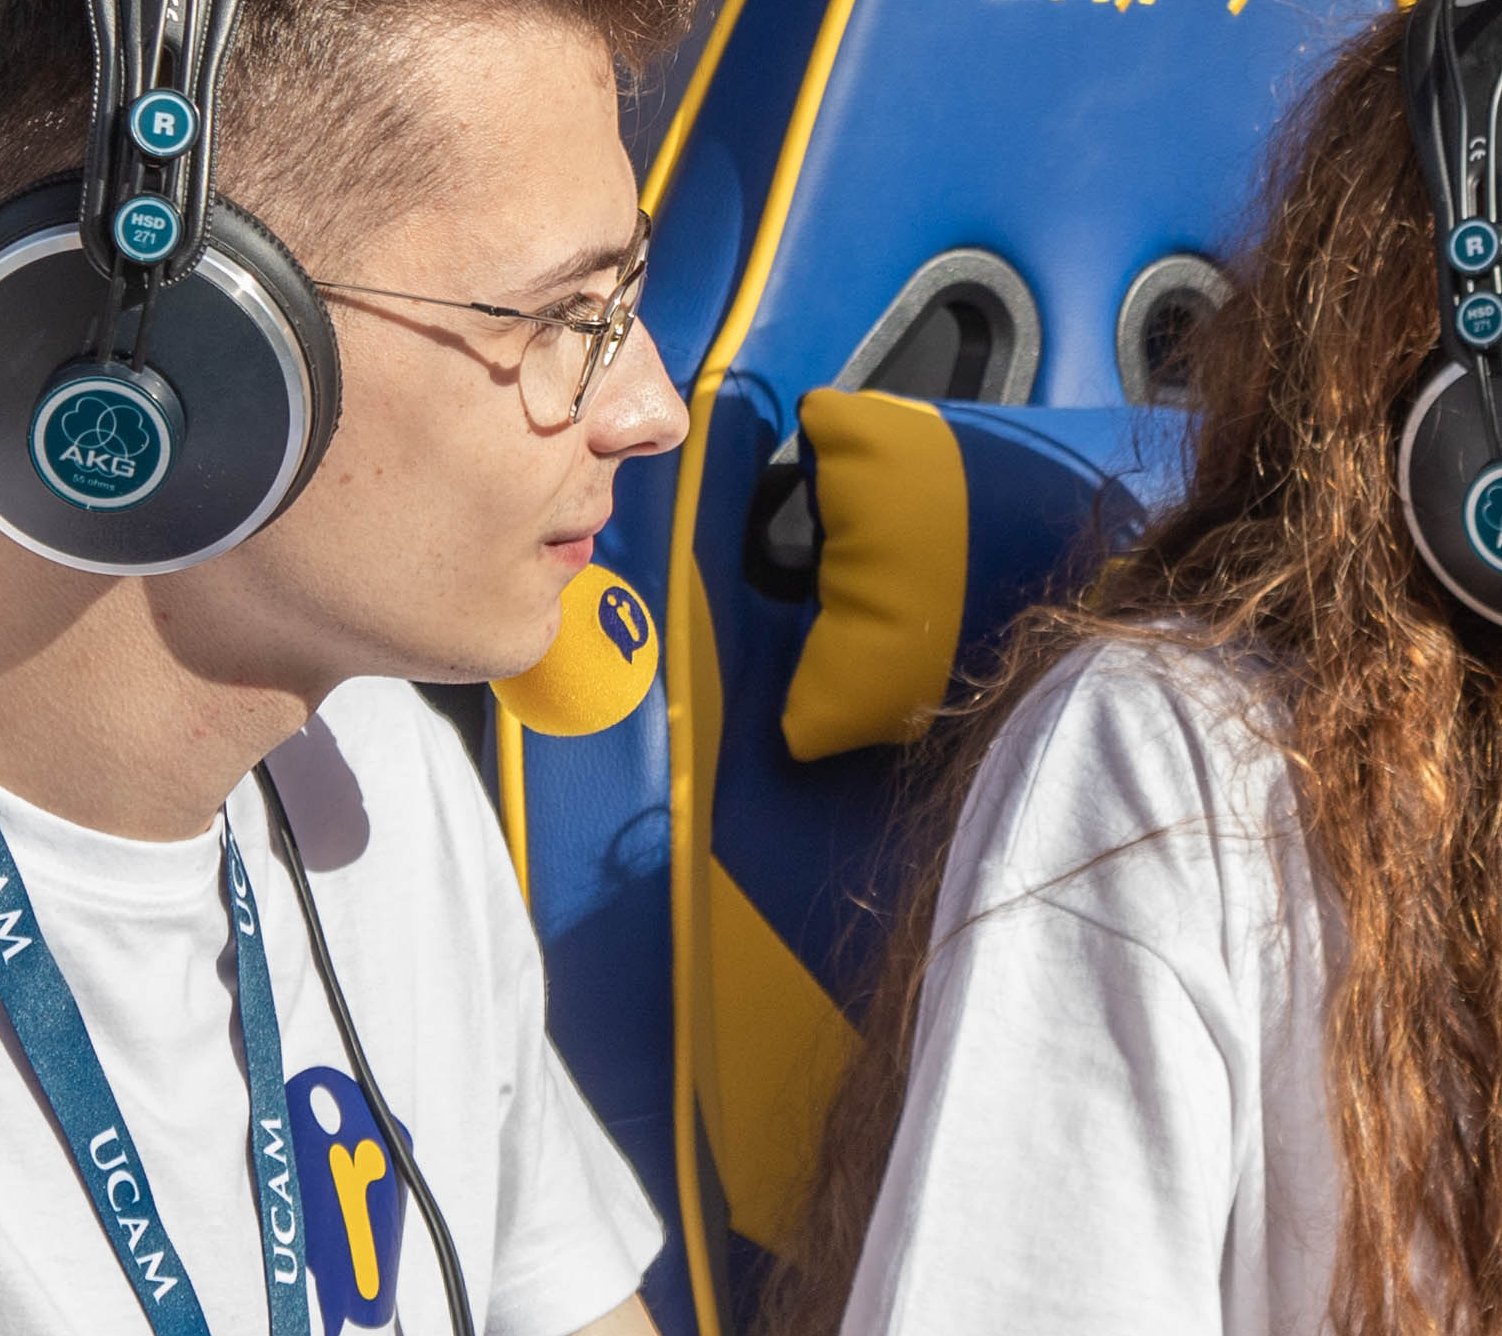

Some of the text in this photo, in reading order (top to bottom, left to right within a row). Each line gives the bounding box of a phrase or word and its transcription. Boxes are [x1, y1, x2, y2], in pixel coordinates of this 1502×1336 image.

[153, 112, 176, 136] R
[130, 213, 166, 230] HSD
[133, 229, 157, 245] 271
[1465, 235, 1485, 257] R
[59, 445, 137, 478] AKG
[260, 1118, 298, 1285] UCAM
[89, 1126, 179, 1306] UCAM
